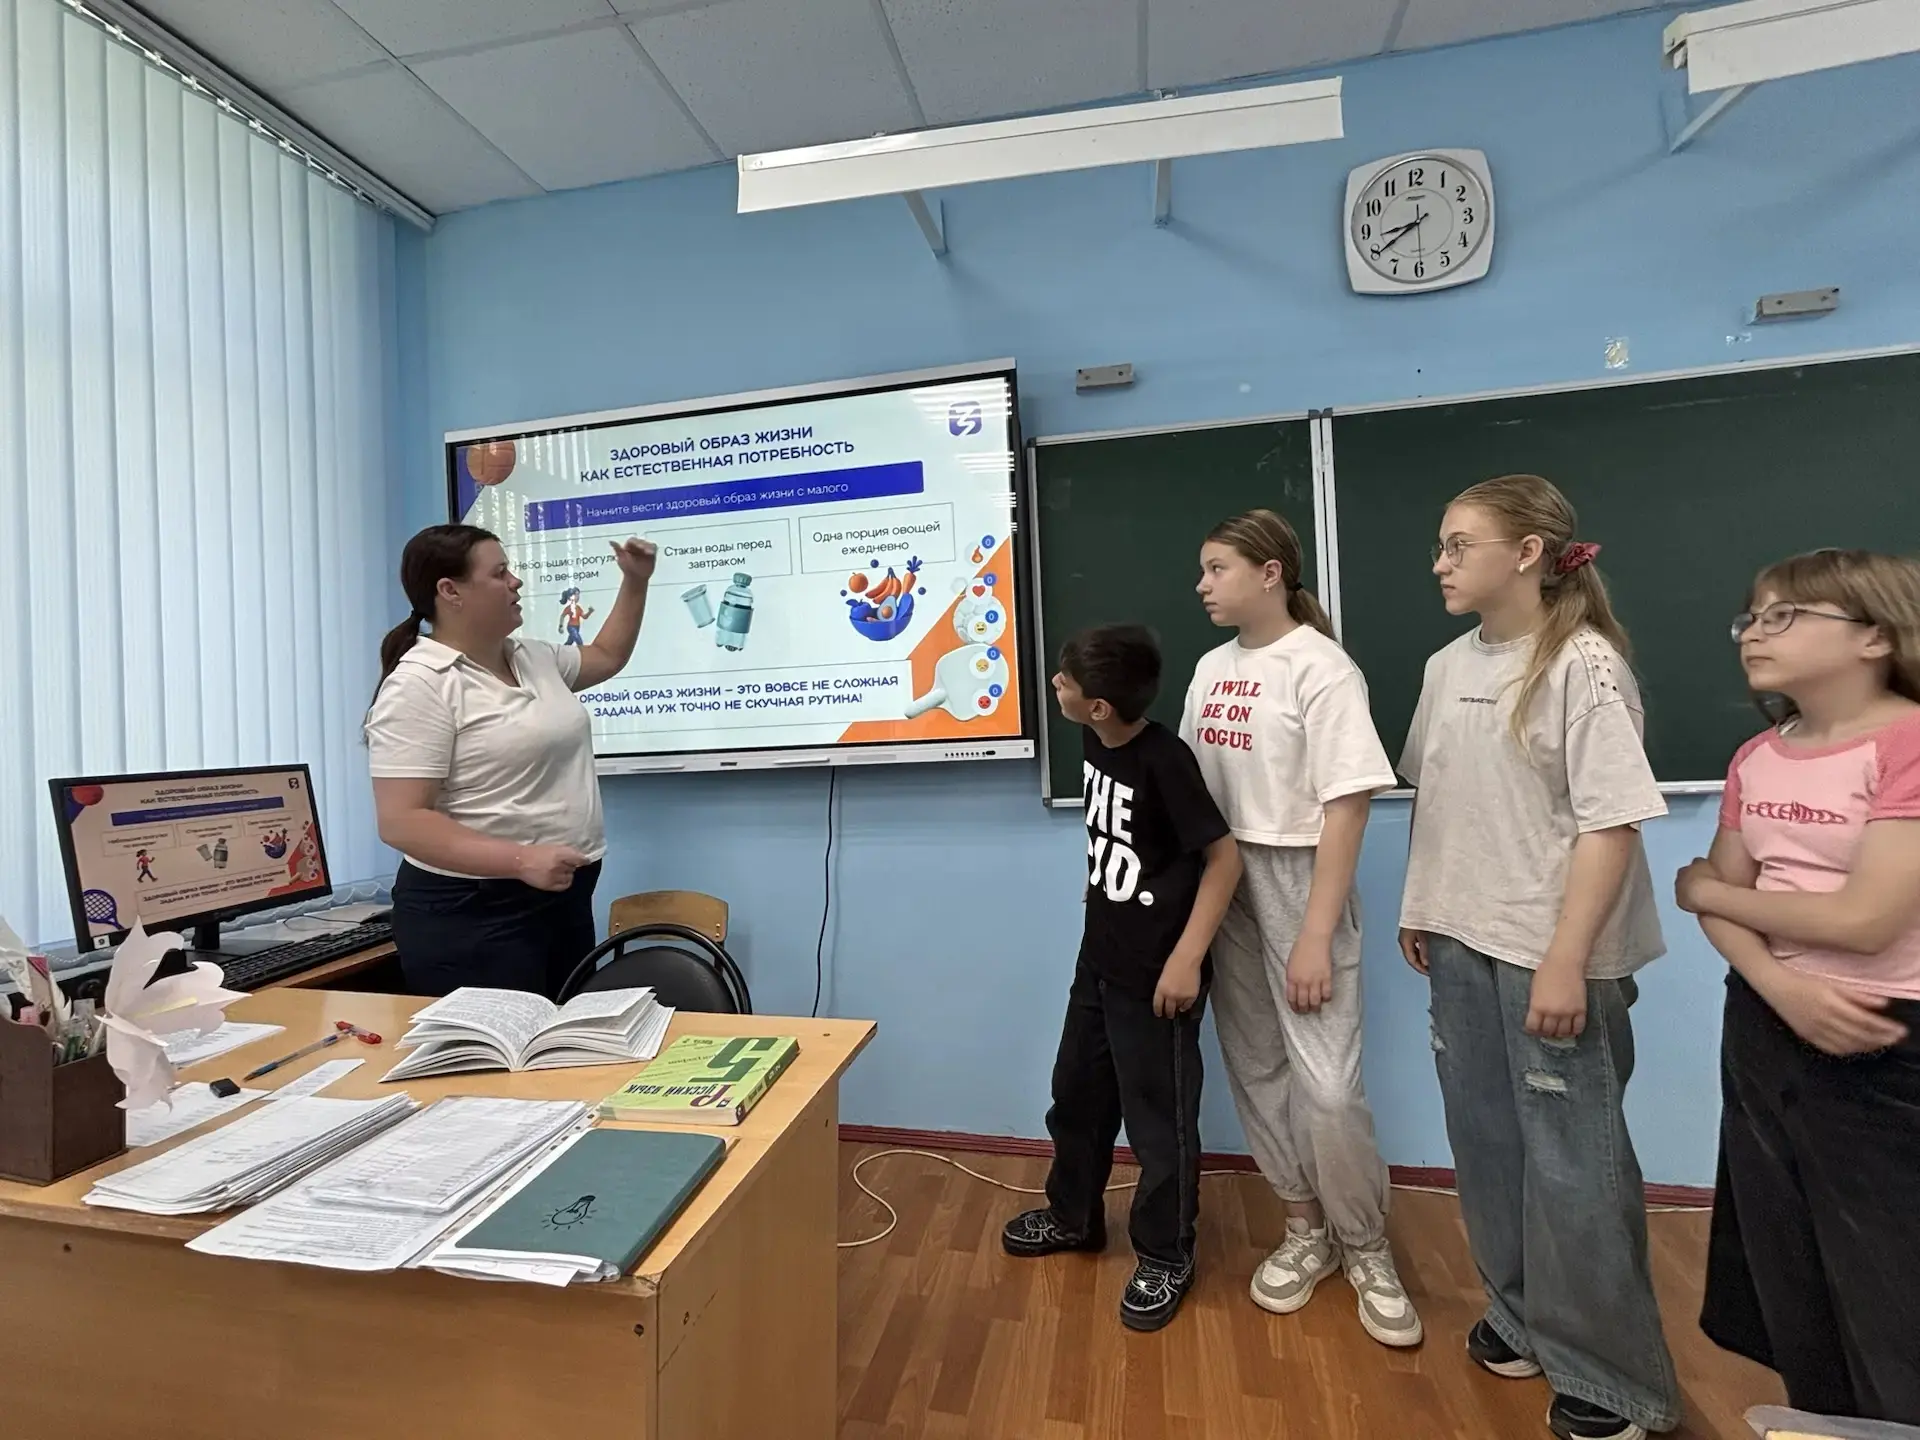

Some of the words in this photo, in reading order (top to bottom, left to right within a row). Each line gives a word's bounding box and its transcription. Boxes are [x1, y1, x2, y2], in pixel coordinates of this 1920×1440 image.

[1408, 168, 1424, 187] 12
[1440, 170, 1446, 188] 1
[1385, 179, 1396, 197] 11
[1456, 185, 1466, 202] 2
[1366, 199, 1381, 217] 10
[1463, 207, 1474, 224] 3
[1361, 224, 1371, 240] 9
[1458, 231, 1469, 248] 4
[1370, 244, 1380, 261] 8
[1440, 250, 1450, 267] 5
[1389, 258, 1399, 275] 7
[1414, 261, 1424, 278] 6
[610, 437, 695, 461] ЗДОРОВЫЙ
[700, 433, 751, 450] ОБРАЗ
[754, 426, 813, 445] ЖИЗНИ
[580, 468, 609, 482] КАК
[614, 454, 734, 478] ЕСТЕСТВЕННАЯ
[738, 441, 855, 464] ПОТРЕБНОСТЬ
[586, 504, 630, 518] Начните
[632, 502, 663, 514] вести
[666, 494, 721, 513] здоровый
[723, 491, 757, 507] образ
[759, 488, 795, 499] жизни
[796, 487, 804, 497] с
[806, 482, 849, 496] малого
[812, 530, 843, 544] Одна
[845, 527, 889, 544] порция
[892, 521, 941, 537] овощей
[664, 544, 703, 557] Стакан
[705, 542, 735, 555] воды
[736, 537, 773, 554] перед
[841, 540, 910, 556] ежедневно
[688, 557, 746, 570] завтраком
[539, 574, 552, 583] по
[579, 689, 630, 703] ОРОВЫЙ
[634, 687, 673, 700] ОБРАЗ
[677, 685, 721, 698] ЖИЗНИ
[737, 684, 761, 695] ЭТО
[765, 681, 808, 693] ВОВСЕ
[812, 680, 830, 690] НЕ
[834, 676, 899, 689] СЛОЖНАЯ
[1210, 682, 1221, 695] I
[1221, 680, 1262, 697] WILL
[594, 703, 641, 717] ЗАДАЧА
[646, 704, 654, 714] И
[658, 703, 676, 714] УЖ
[681, 700, 721, 712] ТОЧНО
[725, 699, 742, 710] НЕ
[745, 696, 804, 710] СКУЧНАЯ
[809, 692, 862, 705] РУТИНА!
[1201, 704, 1225, 719] BE
[1227, 704, 1253, 723] ON
[1197, 727, 1253, 751] VOGUE
[1083, 759, 1134, 845] THE
[688, 1037, 779, 1083] 5
[623, 1084, 664, 1096] язык
[662, 1083, 737, 1107] Русский
